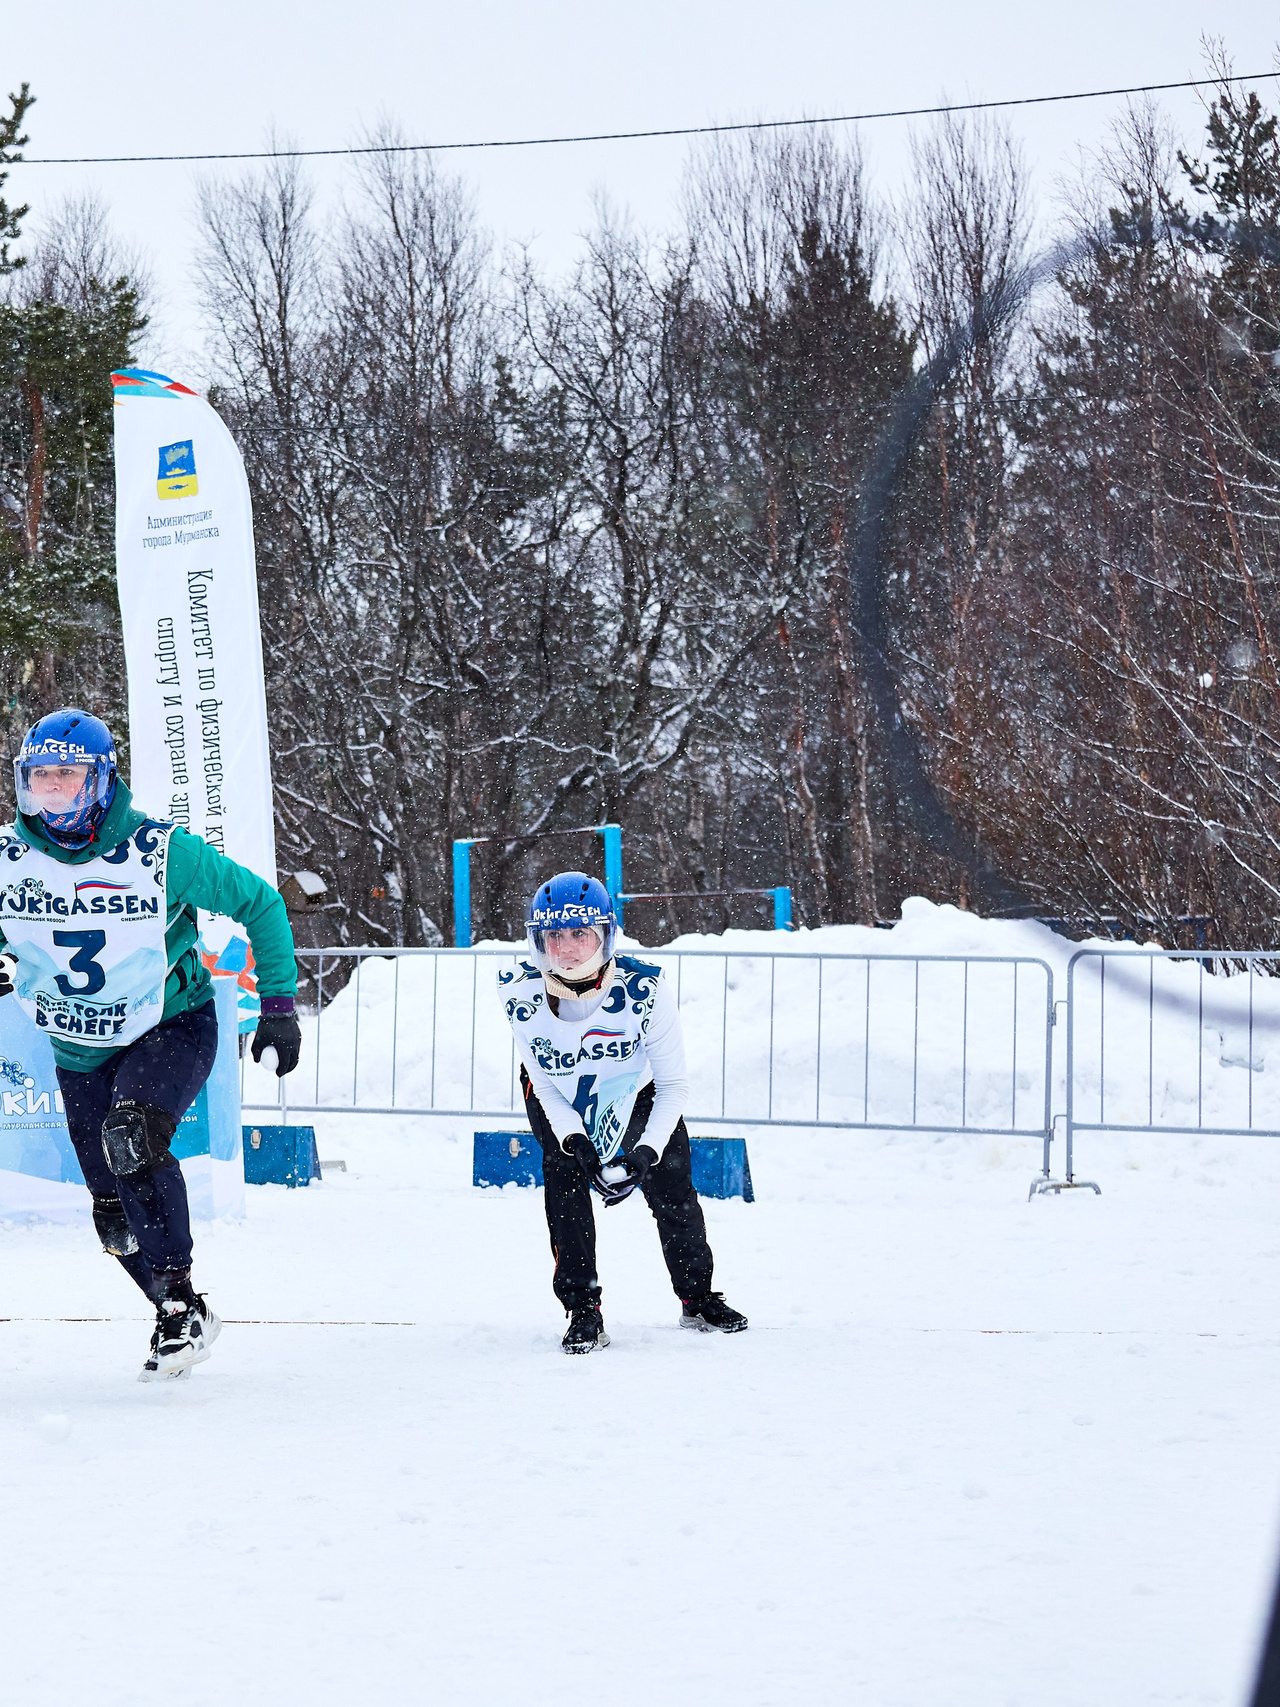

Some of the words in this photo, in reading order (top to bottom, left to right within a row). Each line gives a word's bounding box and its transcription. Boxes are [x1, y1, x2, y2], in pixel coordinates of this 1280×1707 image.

[147, 509, 213, 530] Администрация
[142, 535, 172, 550] города
[174, 527, 220, 546] Мурманска
[187, 568, 214, 660] Комитет
[154, 617, 181, 686] спорту
[197, 666, 216, 691] по
[163, 694, 183, 708] и
[164, 714, 189, 785] охране
[195, 698, 227, 818] физической
[168, 792, 191, 833] здо
[52, 929, 107, 997] 3
[35, 1008, 49, 1027] В
[53, 1012, 127, 1036] СНЕГЕ
[73, 1003, 128, 1019] ТОЛК
[3, 1121, 62, 1131] МУРМАНСКАЯ
